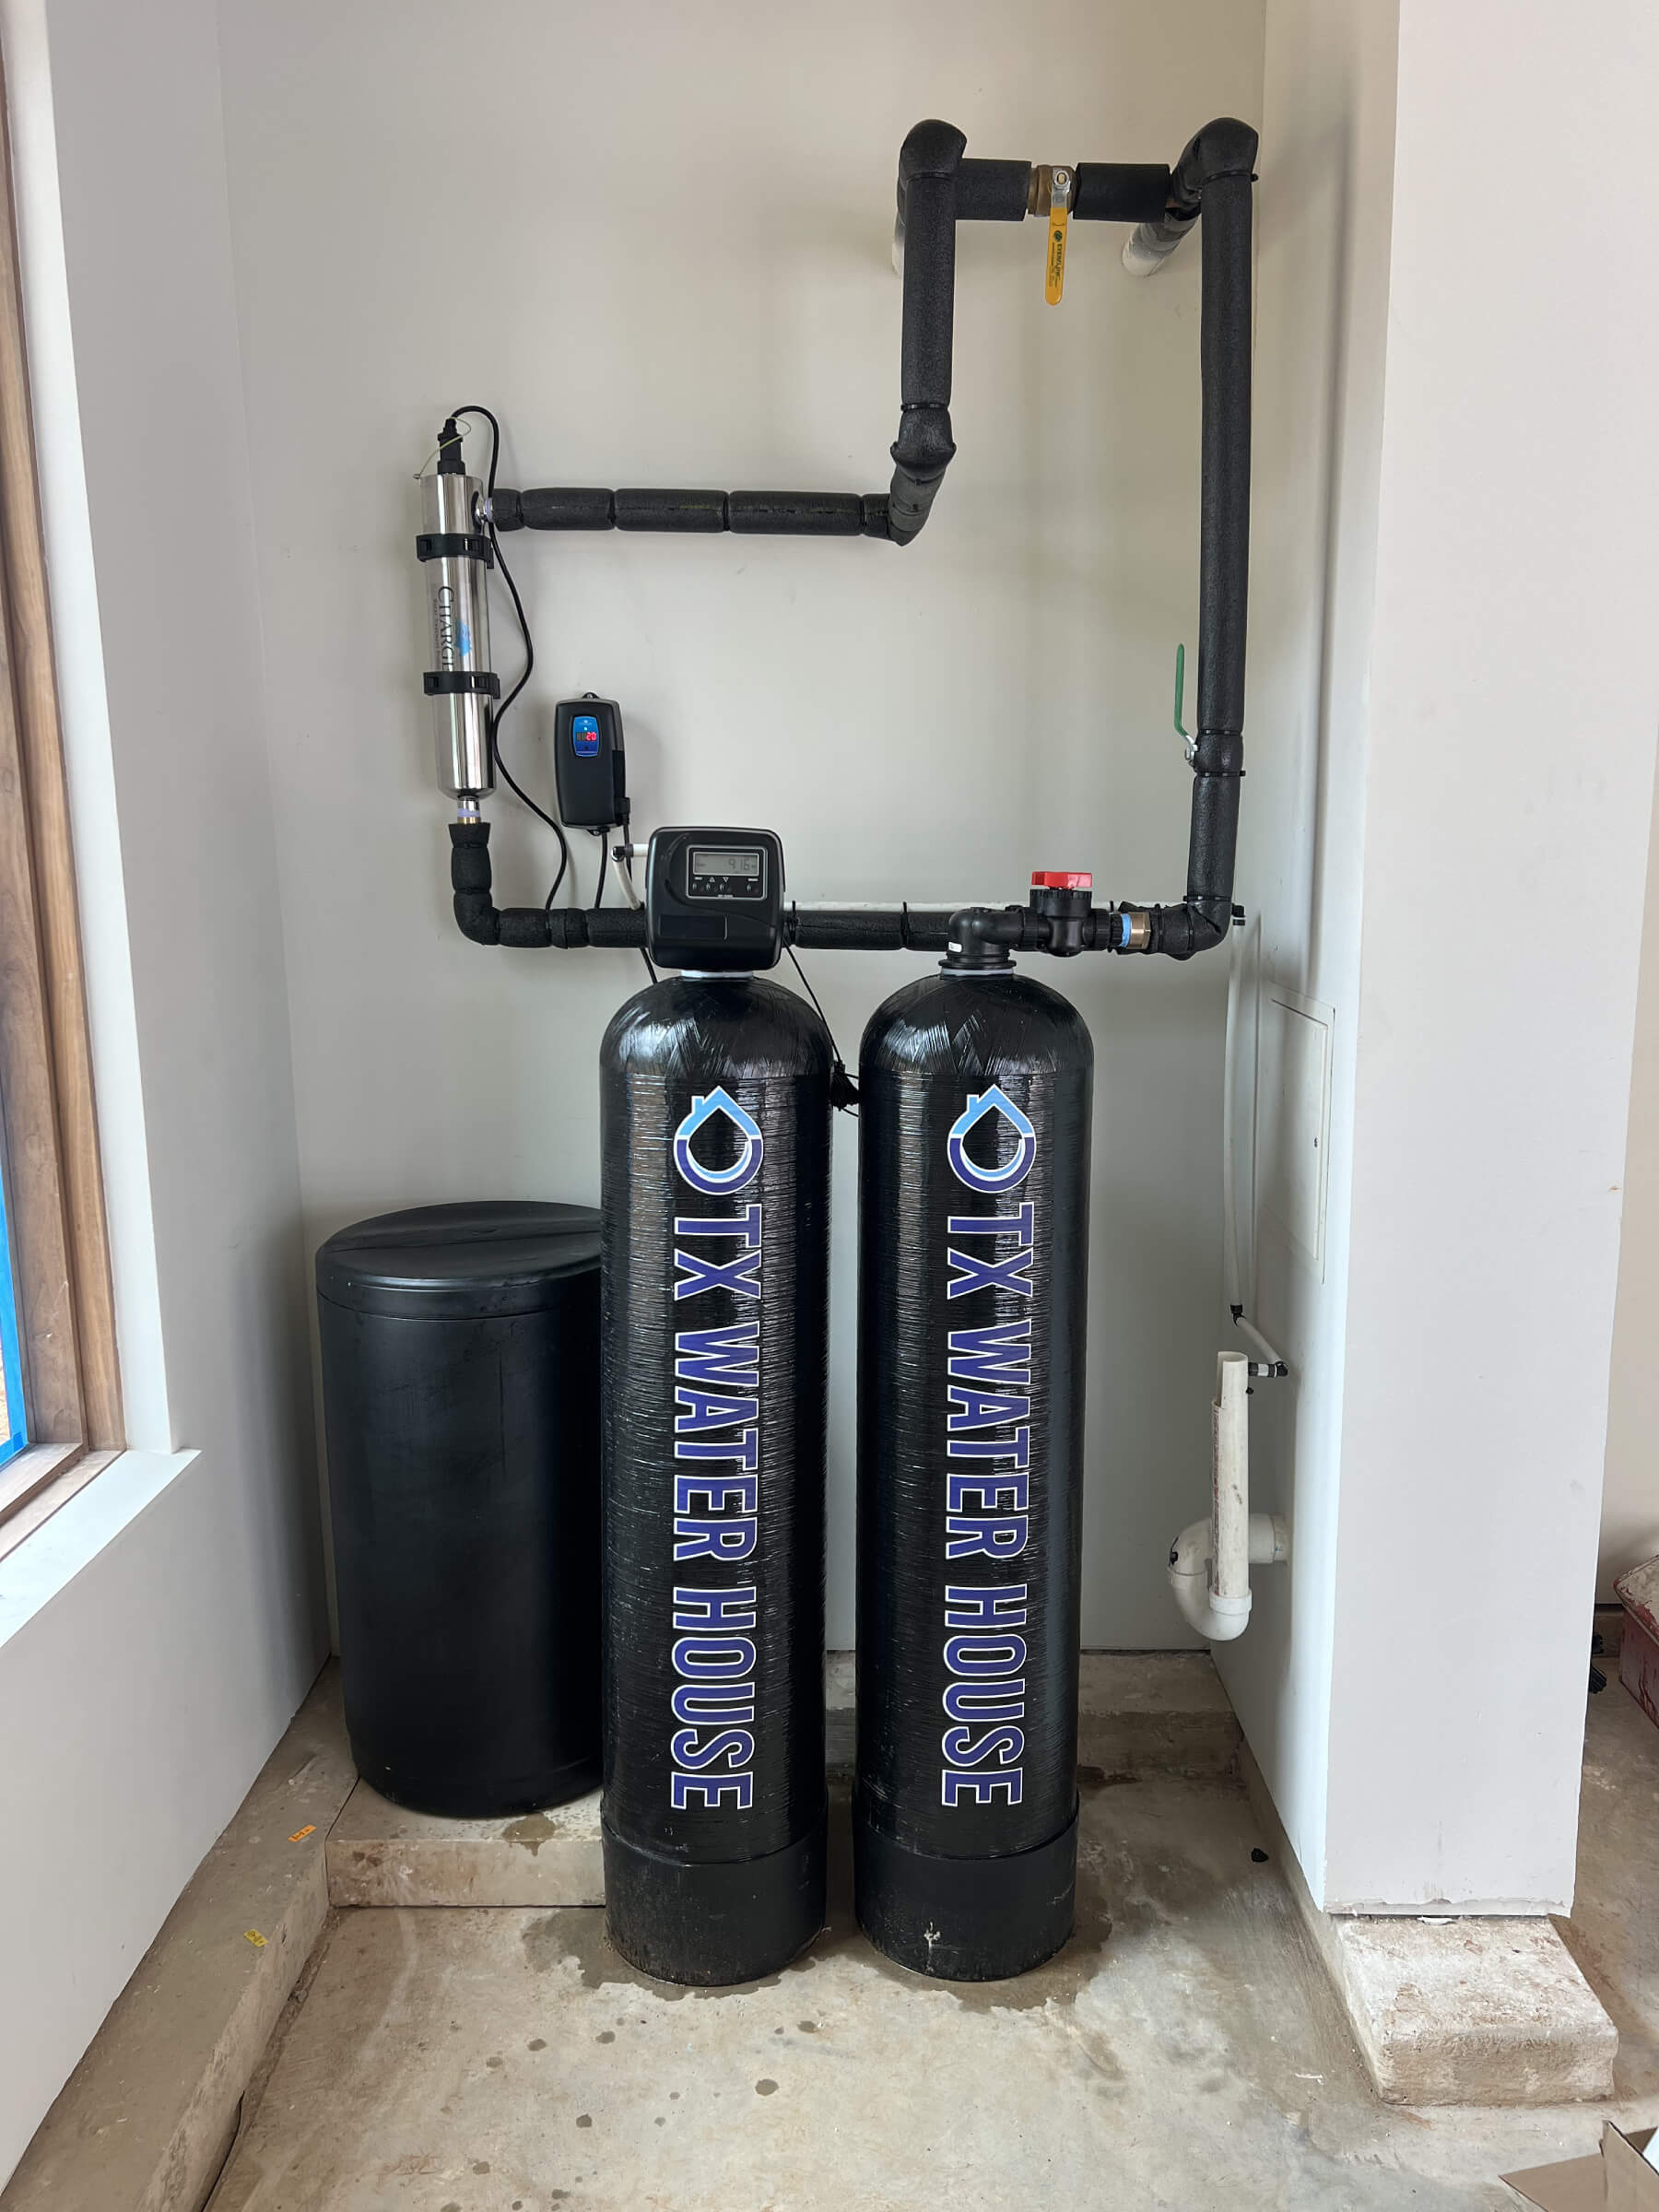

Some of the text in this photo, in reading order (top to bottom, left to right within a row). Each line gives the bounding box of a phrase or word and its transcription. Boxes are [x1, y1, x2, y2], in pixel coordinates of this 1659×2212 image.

[585, 731, 597, 741] 20
[670, 1204, 763, 1809] TX WATER HOUSE
[941, 1202, 1035, 1807] TX WATER HOUSE
